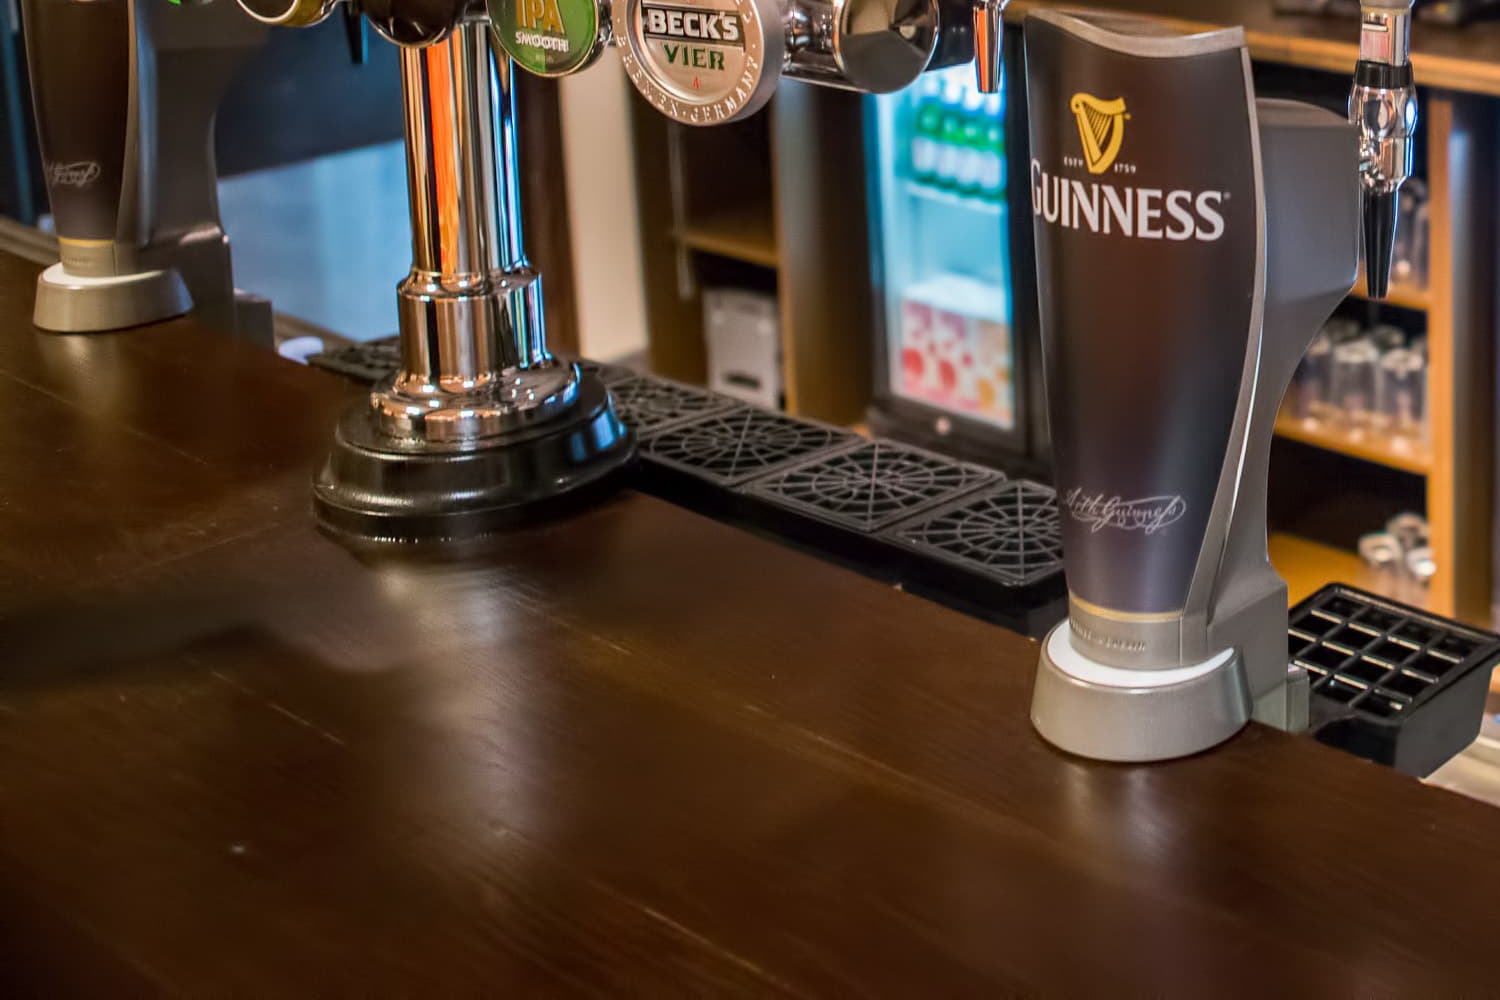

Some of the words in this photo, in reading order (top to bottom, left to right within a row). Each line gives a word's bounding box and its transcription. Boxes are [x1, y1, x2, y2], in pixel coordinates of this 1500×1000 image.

[647, 8, 739, 41] BECK'S
[515, 31, 569, 52] SMOOTH
[664, 44, 725, 71] VIER
[1030, 157, 1225, 242] GUINNESS
